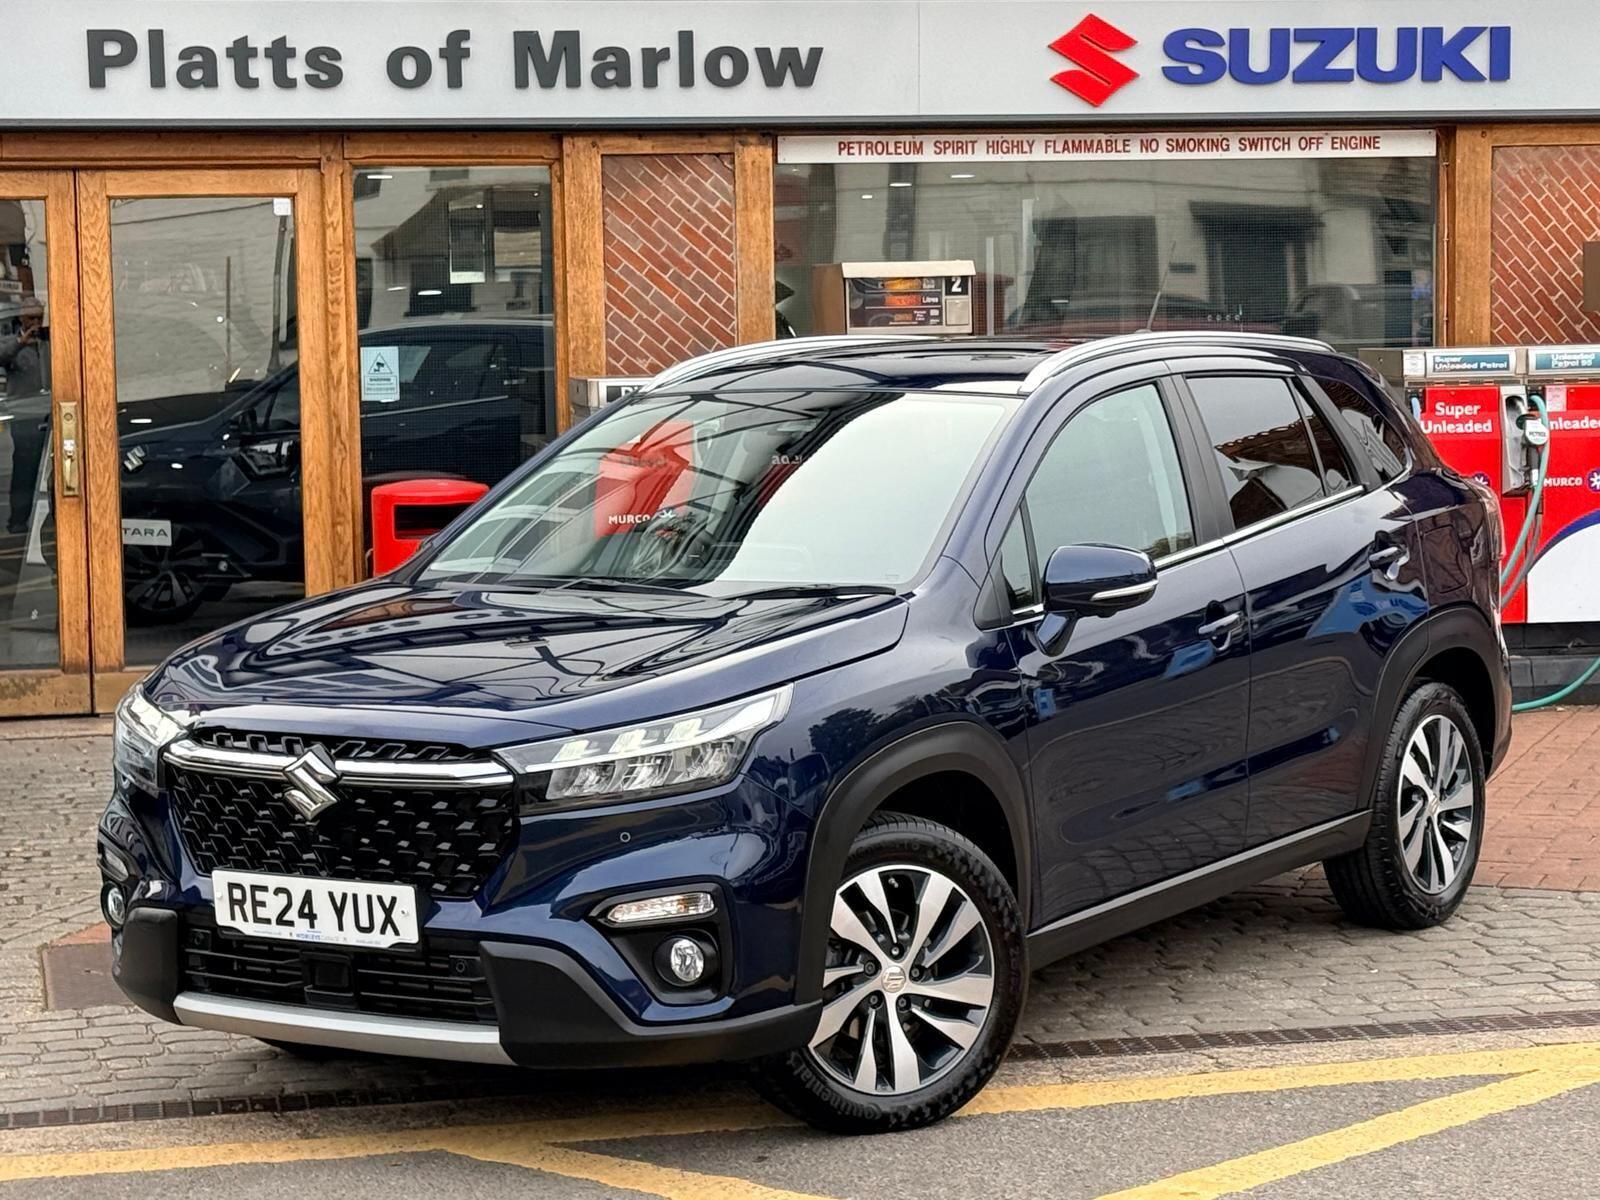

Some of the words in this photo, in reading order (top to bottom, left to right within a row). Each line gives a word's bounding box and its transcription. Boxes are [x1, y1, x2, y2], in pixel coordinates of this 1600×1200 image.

[86, 28, 344, 90] Platts
[386, 29, 471, 89] of
[514, 29, 825, 89] Marlow
[1161, 26, 1512, 86] SUZUKI
[837, 140, 924, 156] PETROLEUM
[933, 139, 979, 155] SPIRIT
[986, 139, 1036, 155] HIGHLY
[1044, 137, 1131, 154] FLAMMABLE
[1139, 137, 1159, 153] NO
[1165, 137, 1231, 153] SMOKING
[1238, 136, 1291, 152] SWITCH
[1298, 135, 1324, 151] OFF
[1330, 135, 1382, 151] ENGINE
[951, 276, 962, 293] 2
[1434, 355, 1463, 364] Super
[1551, 352, 1596, 360] Unleaded
[1551, 359, 1579, 368] Petrol
[1434, 362, 1479, 371] Unleaded
[1479, 361, 1508, 370] Petrol
[1434, 401, 1482, 419] Super
[1420, 418, 1493, 434] Unleaded
[1549, 415, 1600, 431] nleade
[1543, 477, 1583, 488] MURCO
[608, 513, 651, 525] MURCO
[122, 527, 169, 538] TARA
[227, 881, 318, 930] RE24
[328, 890, 401, 937] YUX
